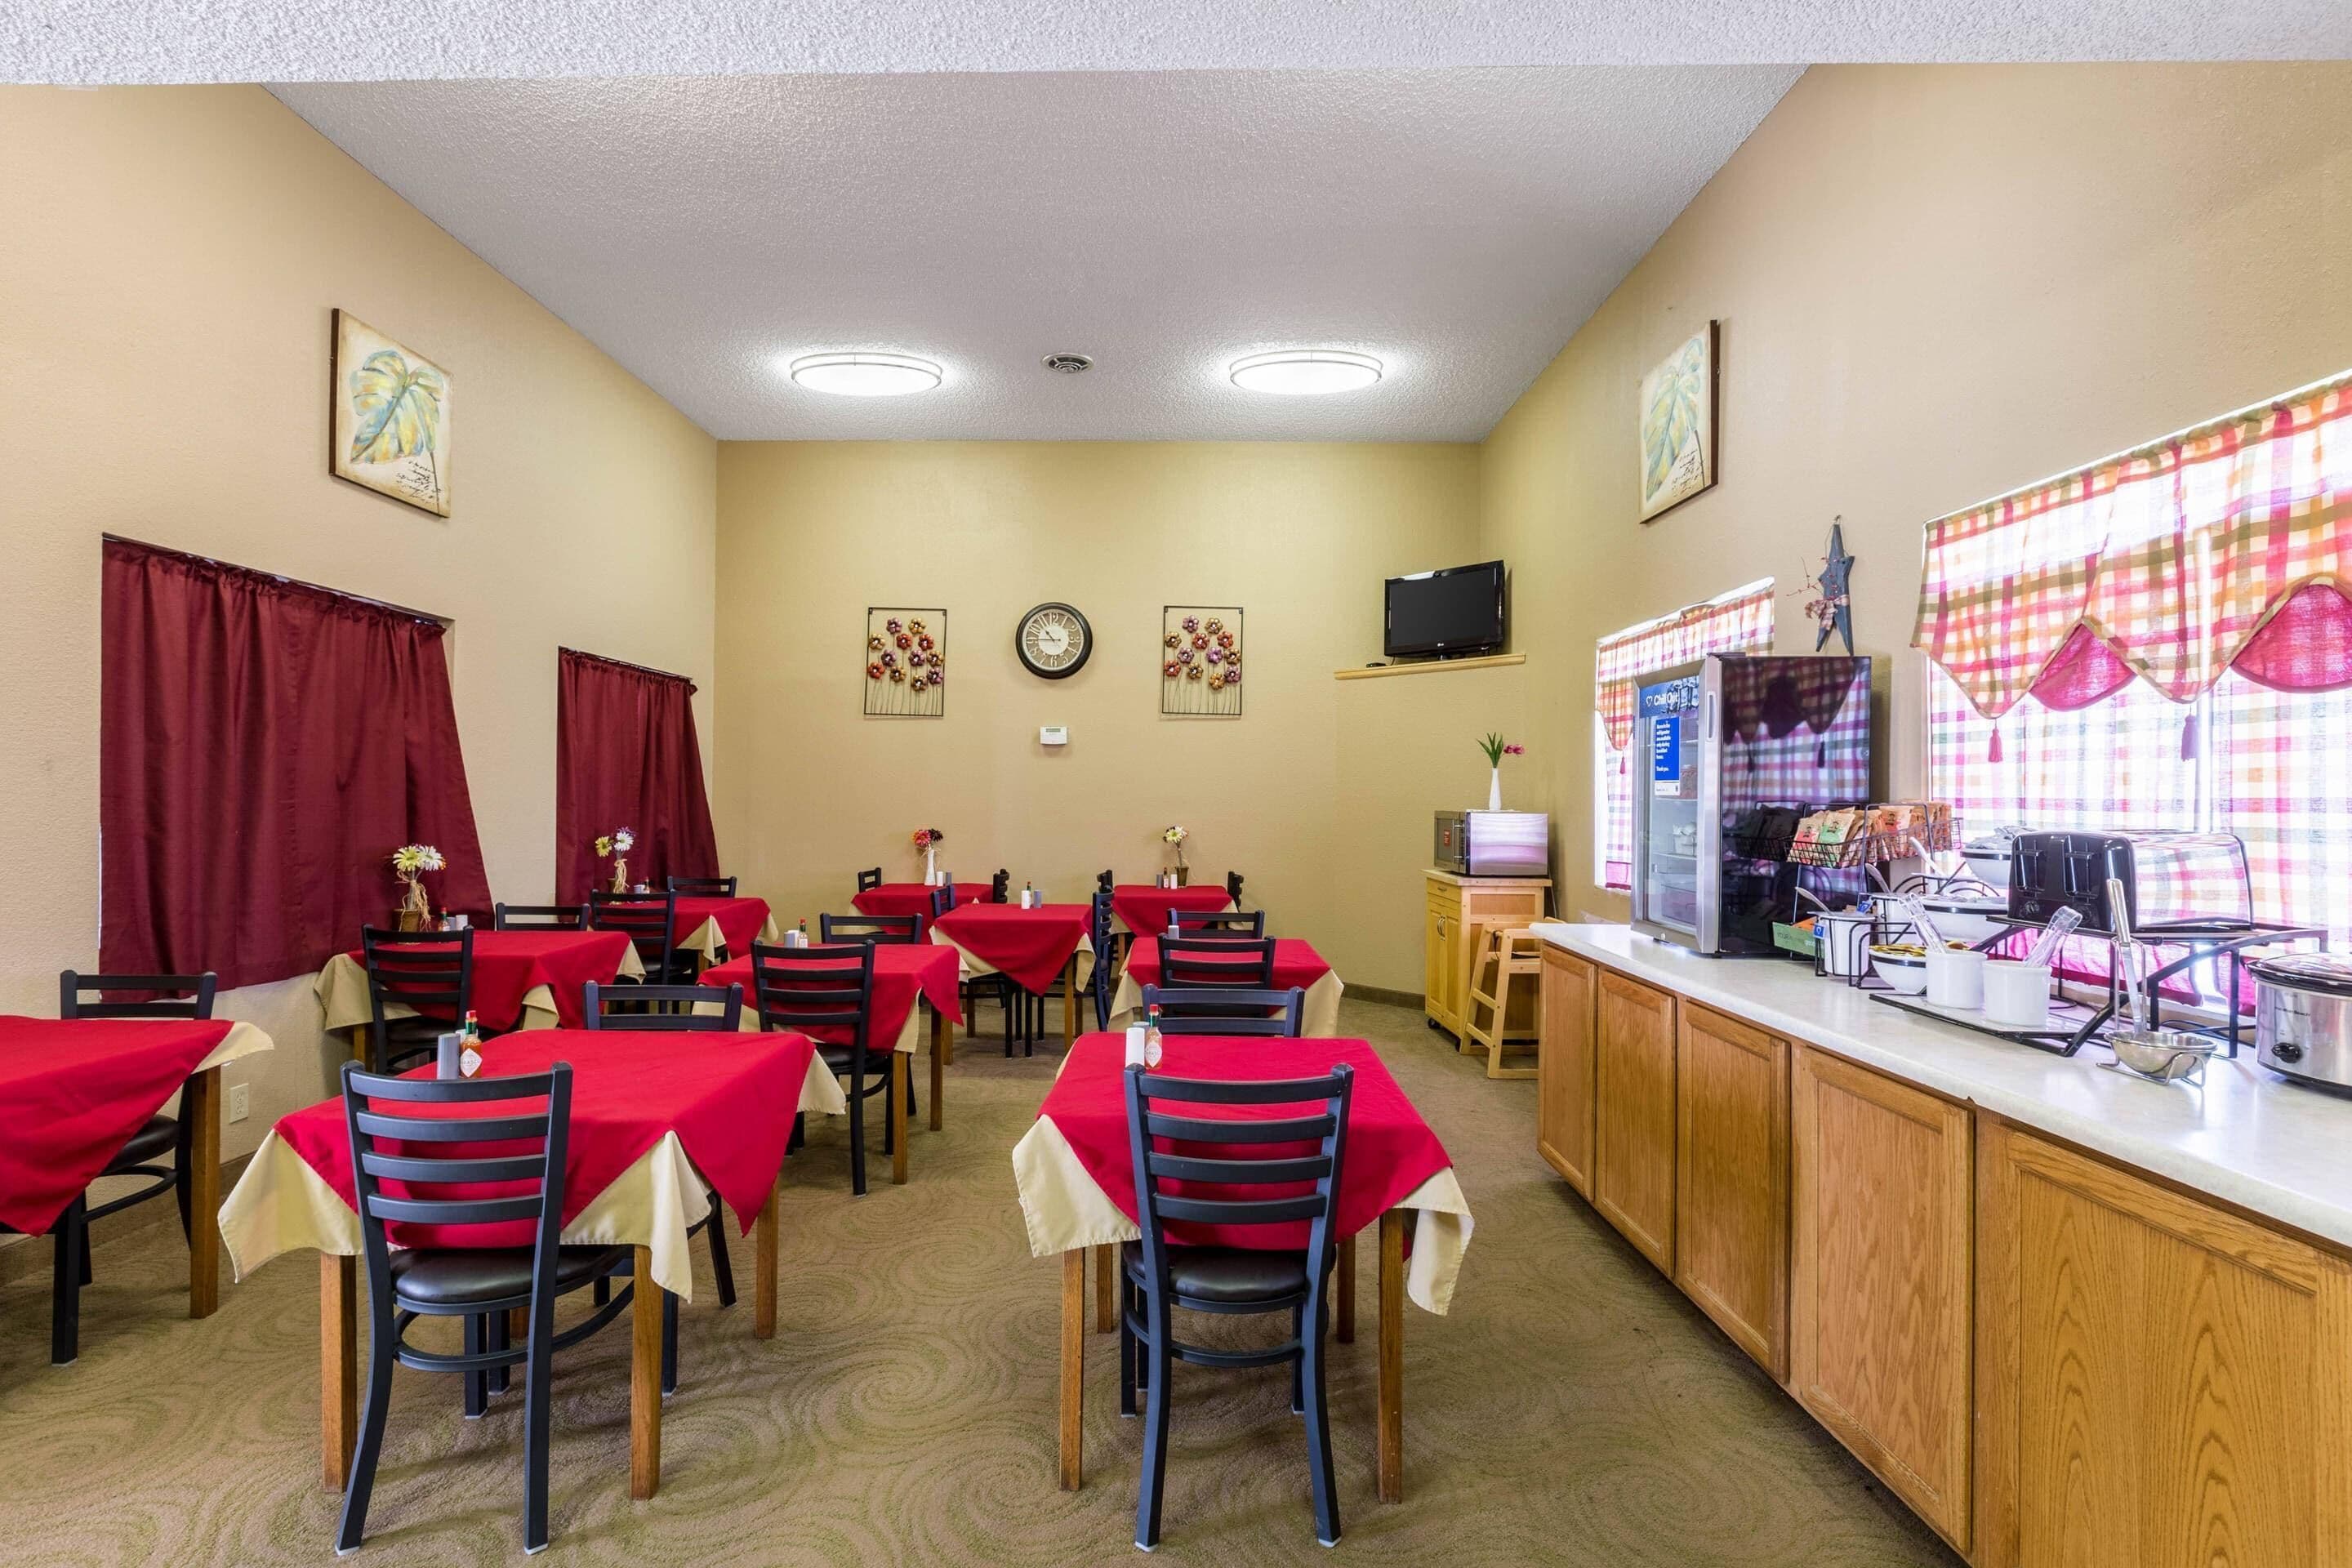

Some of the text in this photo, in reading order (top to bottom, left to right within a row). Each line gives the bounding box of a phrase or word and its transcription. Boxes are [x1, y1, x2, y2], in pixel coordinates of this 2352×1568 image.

[1038, 614, 1049, 628] 11
[1049, 612, 1059, 626] 12
[1061, 616, 1069, 627] 1
[1029, 623, 1041, 635] 10
[1066, 624, 1079, 634] 2
[1030, 647, 1039, 656] 8
[1050, 655, 1058, 667] 6
